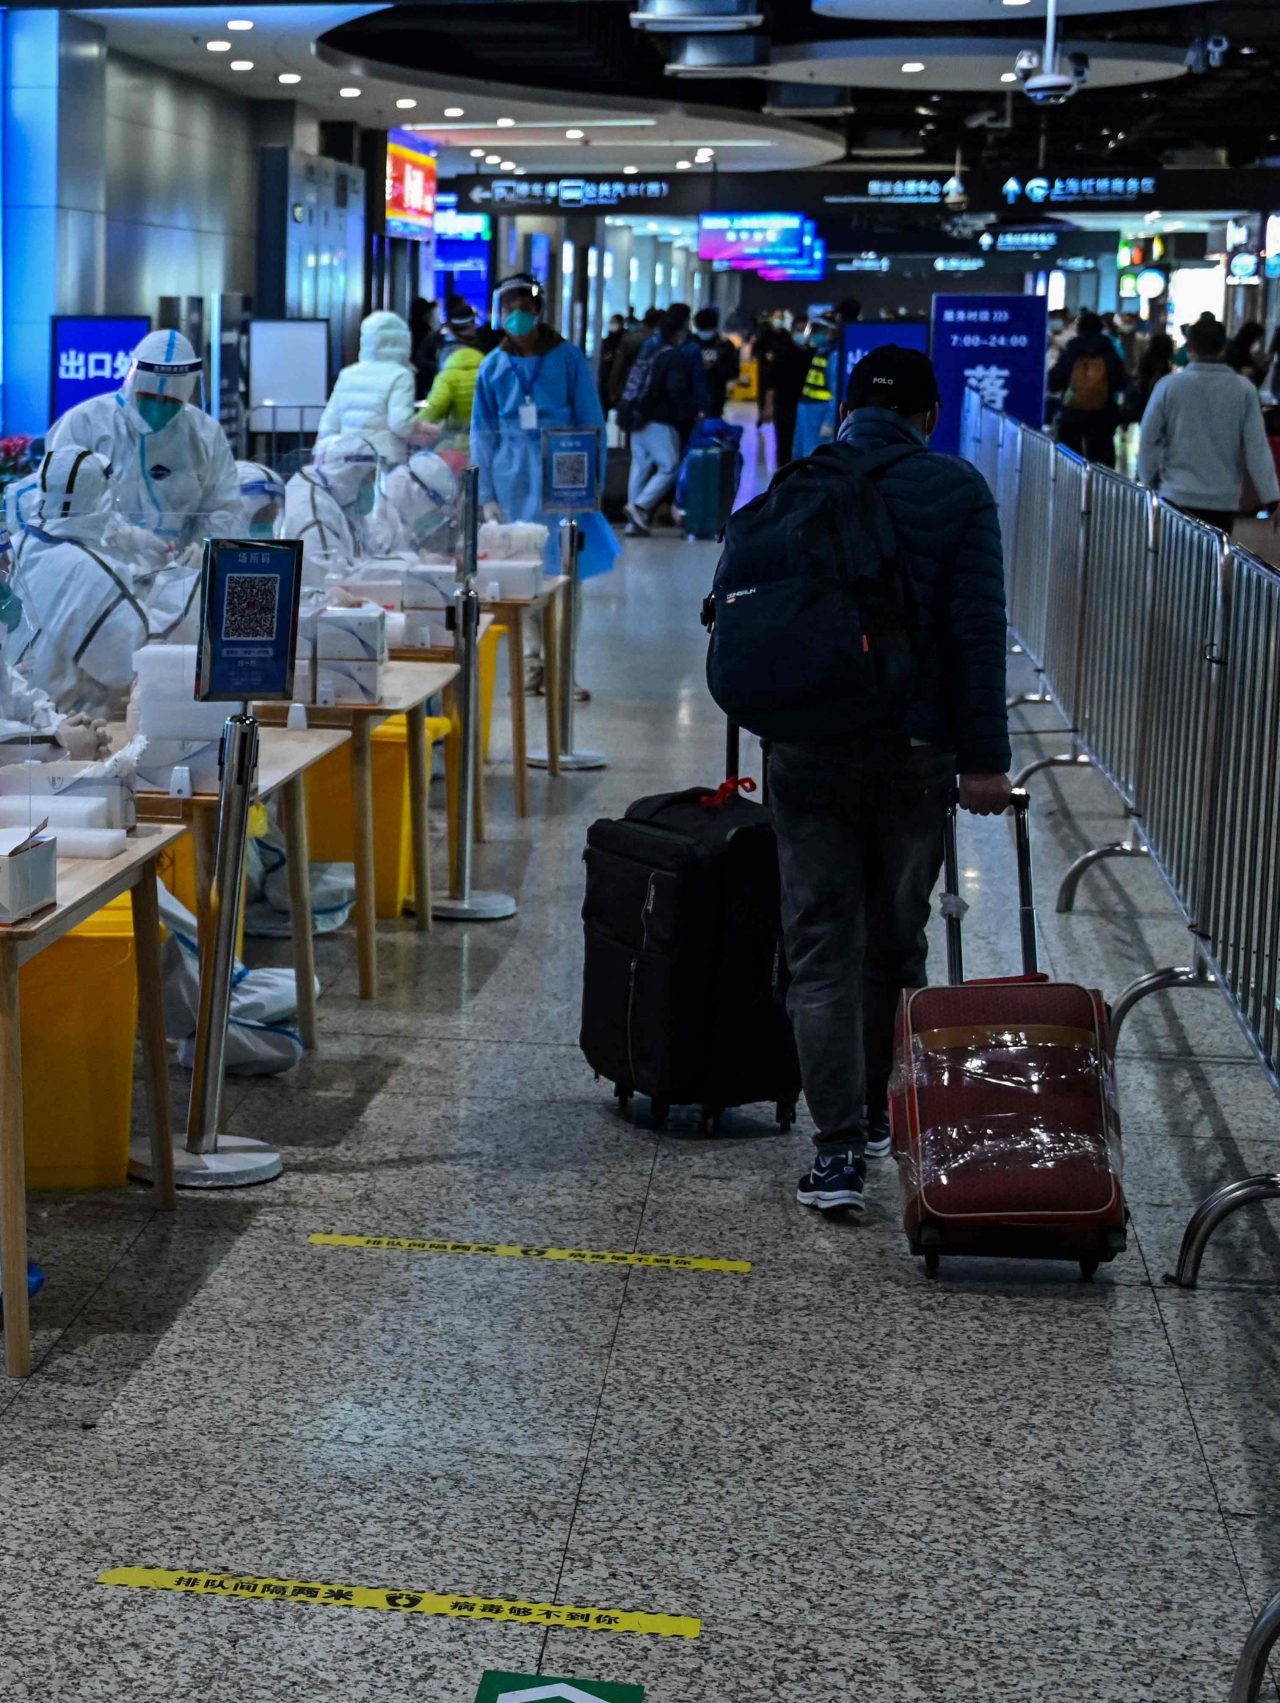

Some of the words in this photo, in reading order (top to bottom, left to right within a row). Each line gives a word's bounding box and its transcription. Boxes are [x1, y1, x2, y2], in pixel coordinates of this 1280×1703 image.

[872, 376, 894, 385] POLO
[174, 1574, 355, 1602] 排队间隔两米
[449, 1600, 621, 1627] 病毒够不到你
